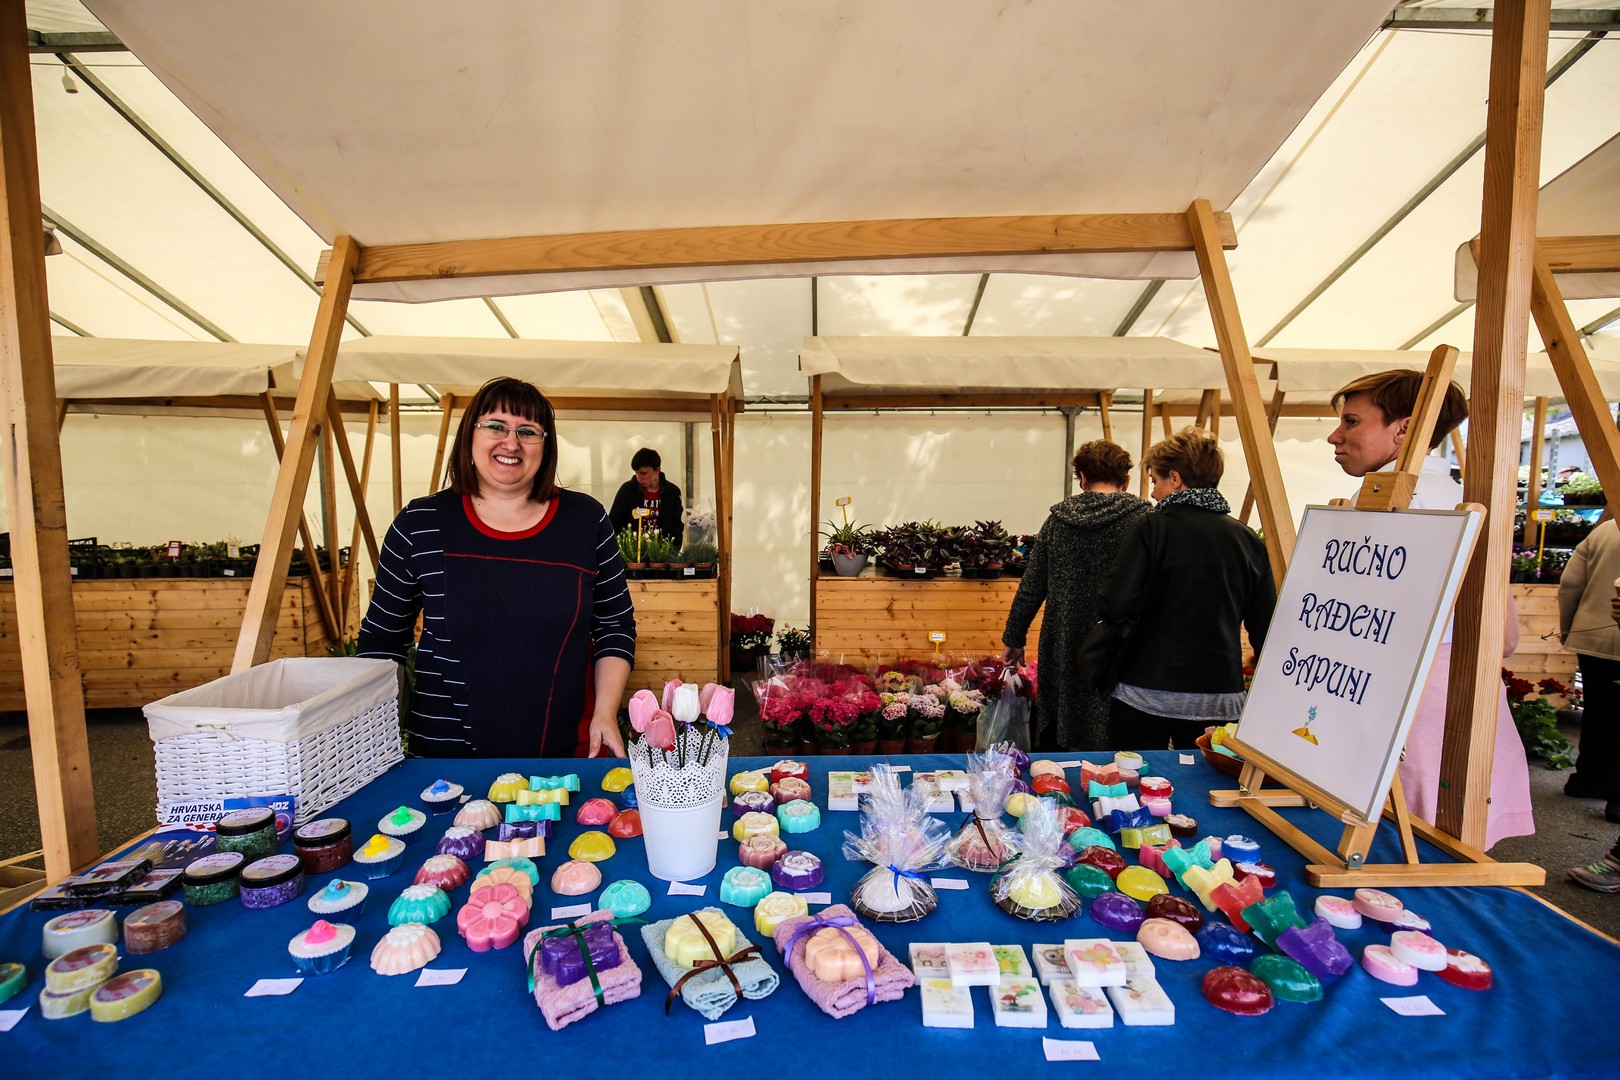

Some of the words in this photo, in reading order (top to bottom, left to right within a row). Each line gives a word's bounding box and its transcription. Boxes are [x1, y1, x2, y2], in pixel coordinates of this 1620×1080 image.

[1321, 535, 1407, 581] RUČNO
[1298, 592, 1396, 645] RAĐENI
[1281, 646, 1373, 706] SAPUNI
[166, 815, 181, 823] ZA
[170, 803, 222, 814] HRVATSKA
